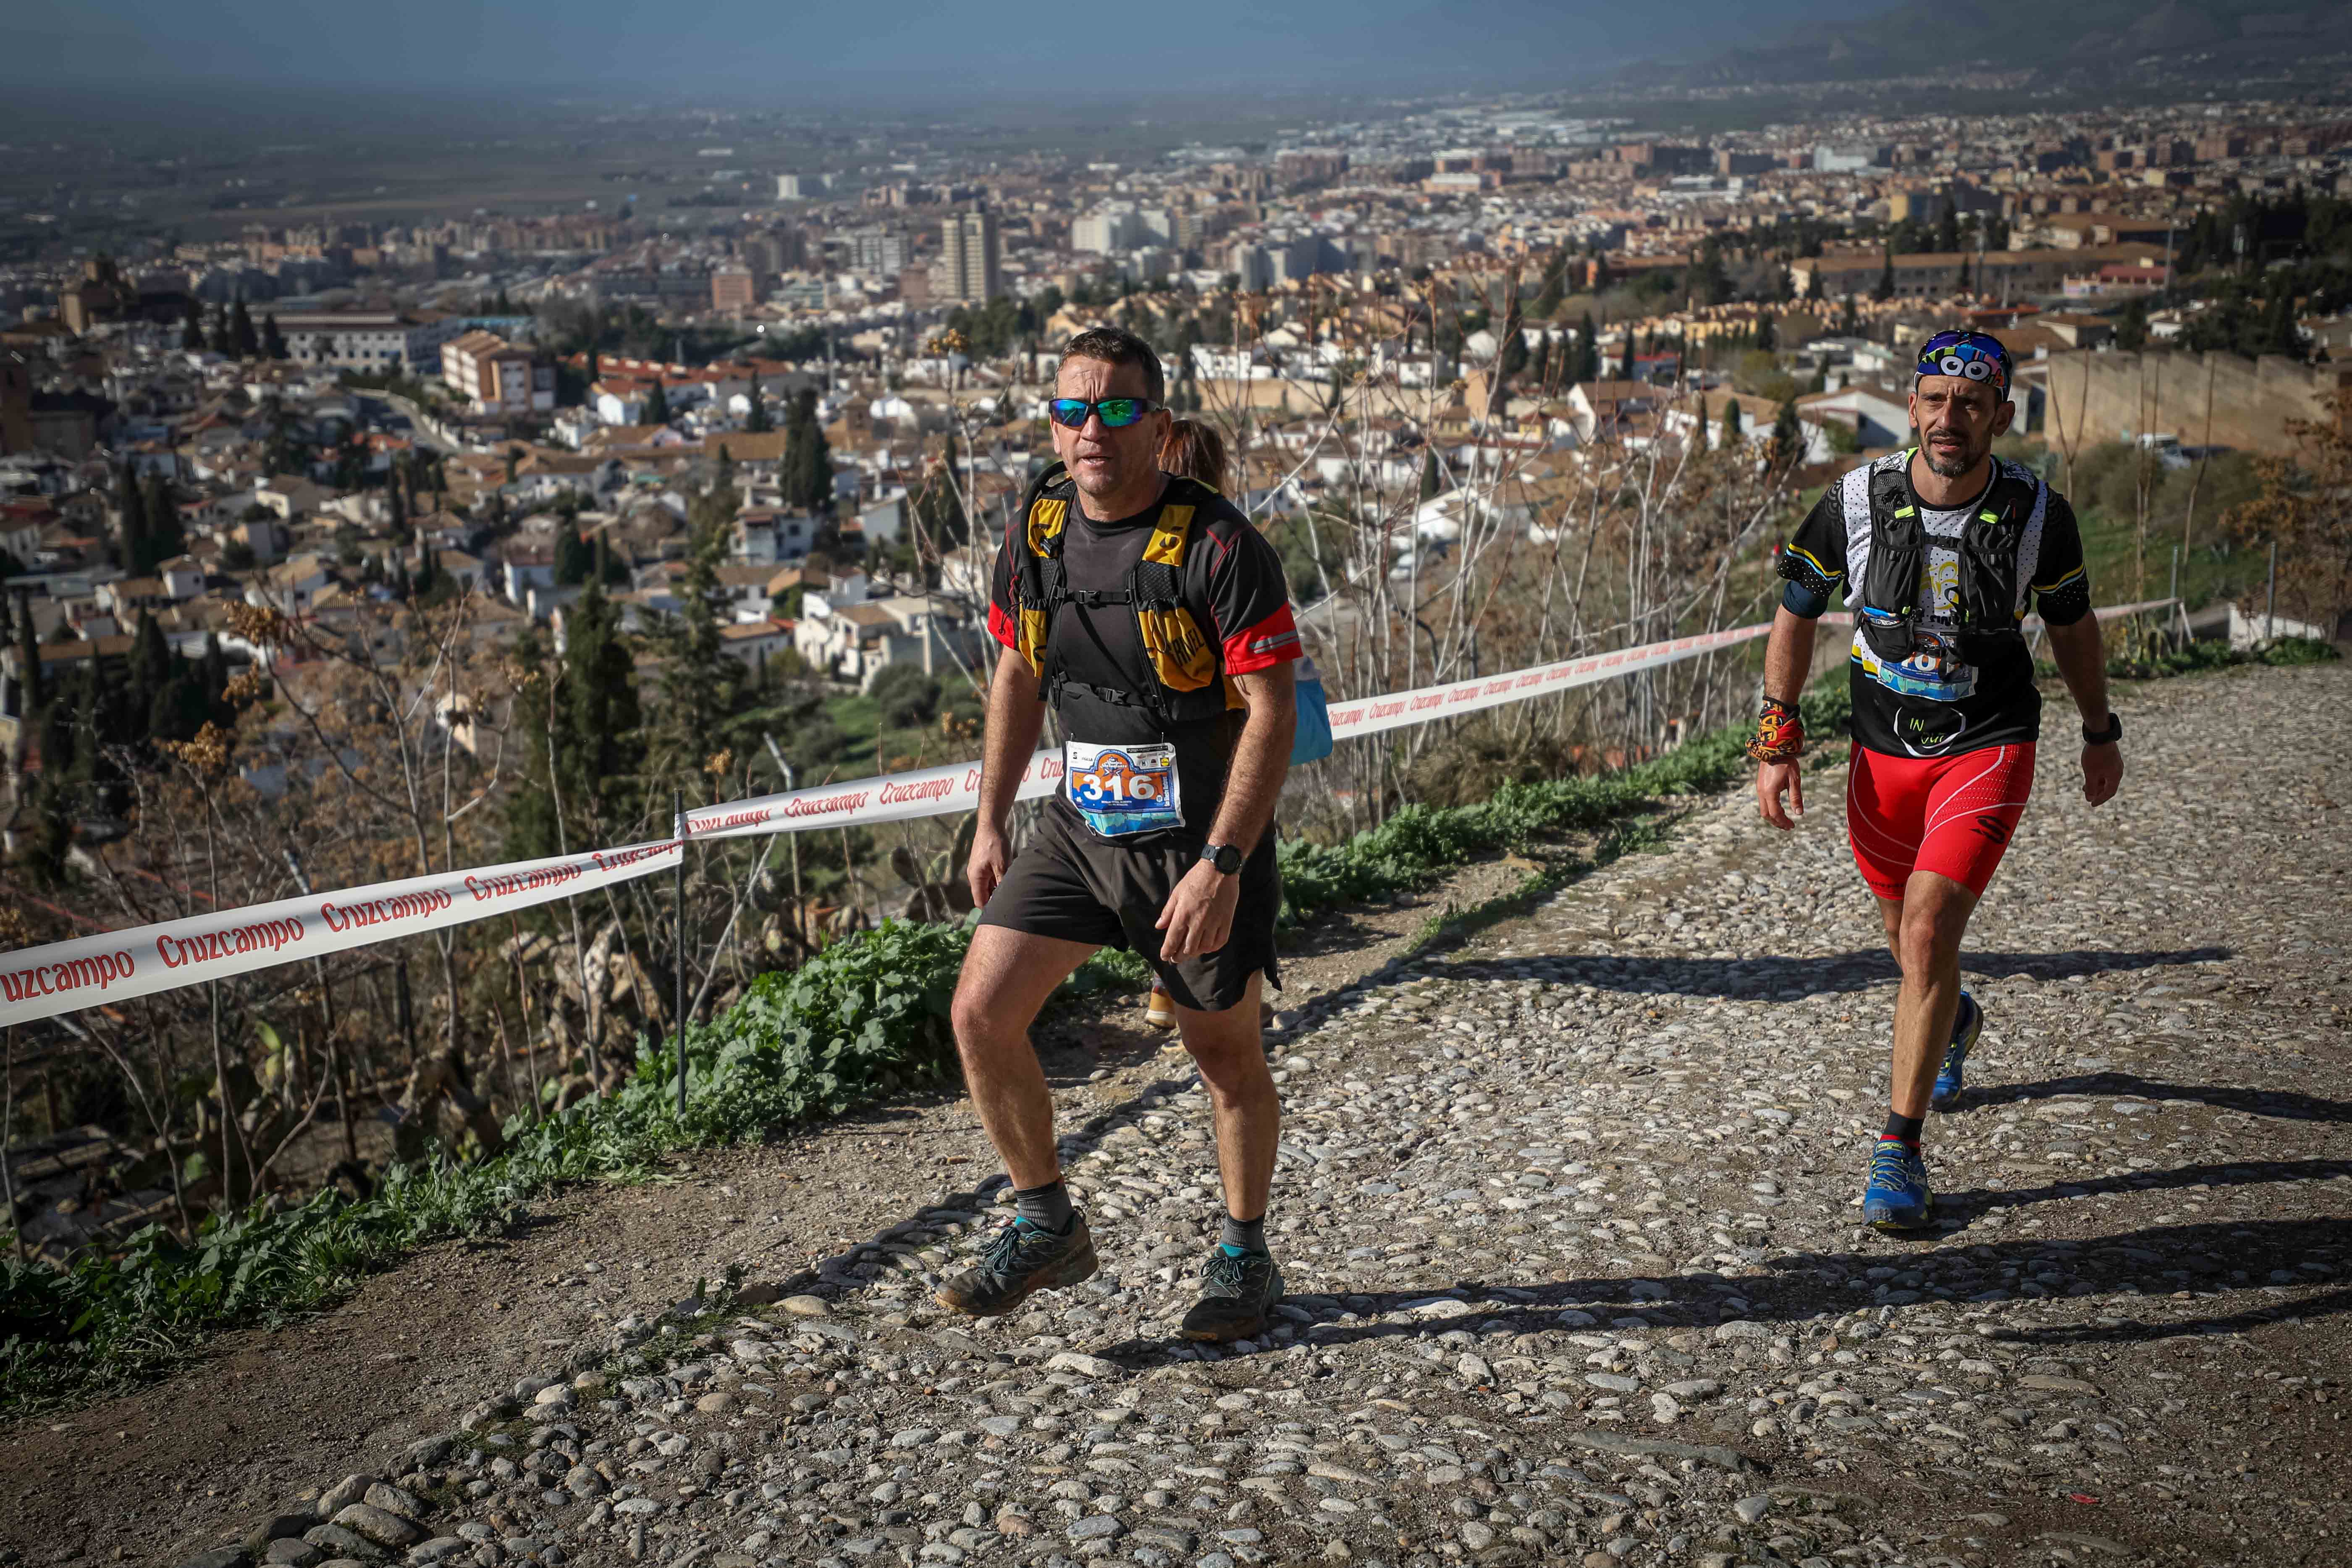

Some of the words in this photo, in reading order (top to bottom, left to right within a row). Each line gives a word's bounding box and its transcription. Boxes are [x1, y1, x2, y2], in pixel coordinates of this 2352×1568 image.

[1910, 718, 1925, 732] IN
[880, 777, 954, 805] Cruzcampo
[1083, 774, 1155, 800] 316
[0, 951, 134, 1002] uzcampo
[157, 917, 304, 968] Cruzcampo
[320, 888, 452, 933] Cruzcampo
[464, 863, 582, 901] Cruzcampo
